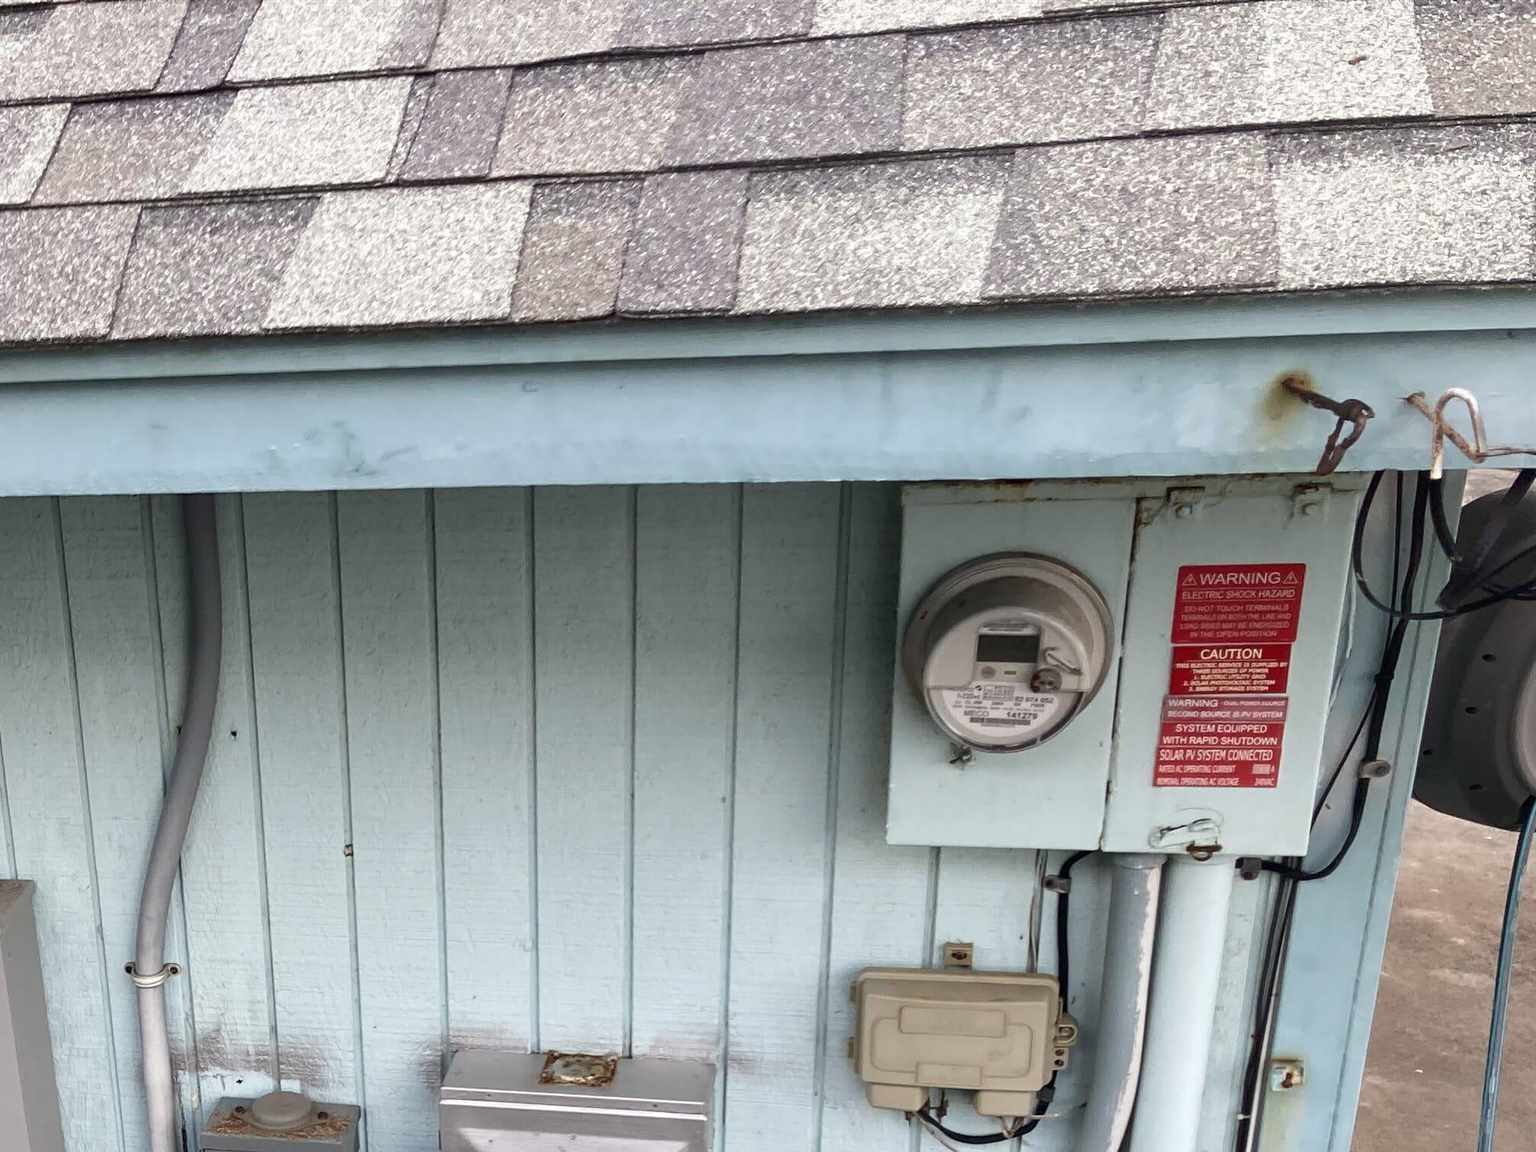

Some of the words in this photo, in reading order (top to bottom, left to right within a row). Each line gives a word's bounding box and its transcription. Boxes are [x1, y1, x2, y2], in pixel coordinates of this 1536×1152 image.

[1200, 571, 1281, 584] WARNING
[1182, 590, 1224, 599] ELECTRIC
[1226, 590, 1257, 599] SHOCK
[1258, 589, 1296, 598] HAZARD
[1200, 648, 1262, 660] CAUTION
[1168, 699, 1218, 707] WARNING
[1168, 710, 1199, 718] SECOND
[1200, 710, 1231, 718] SOURCE
[1253, 710, 1283, 718] SYSTEM
[1175, 724, 1215, 733] SYSTEM
[1217, 724, 1268, 733] EQUIPPED
[1163, 736, 1187, 745] WITH
[1189, 736, 1218, 745] RAPID
[1221, 736, 1277, 745] SHUTDOWN
[1159, 749, 1184, 761] SOLAR
[1185, 749, 1196, 761] PV
[1197, 749, 1226, 761] SYSTEM
[1227, 749, 1273, 761] CONNECTED
